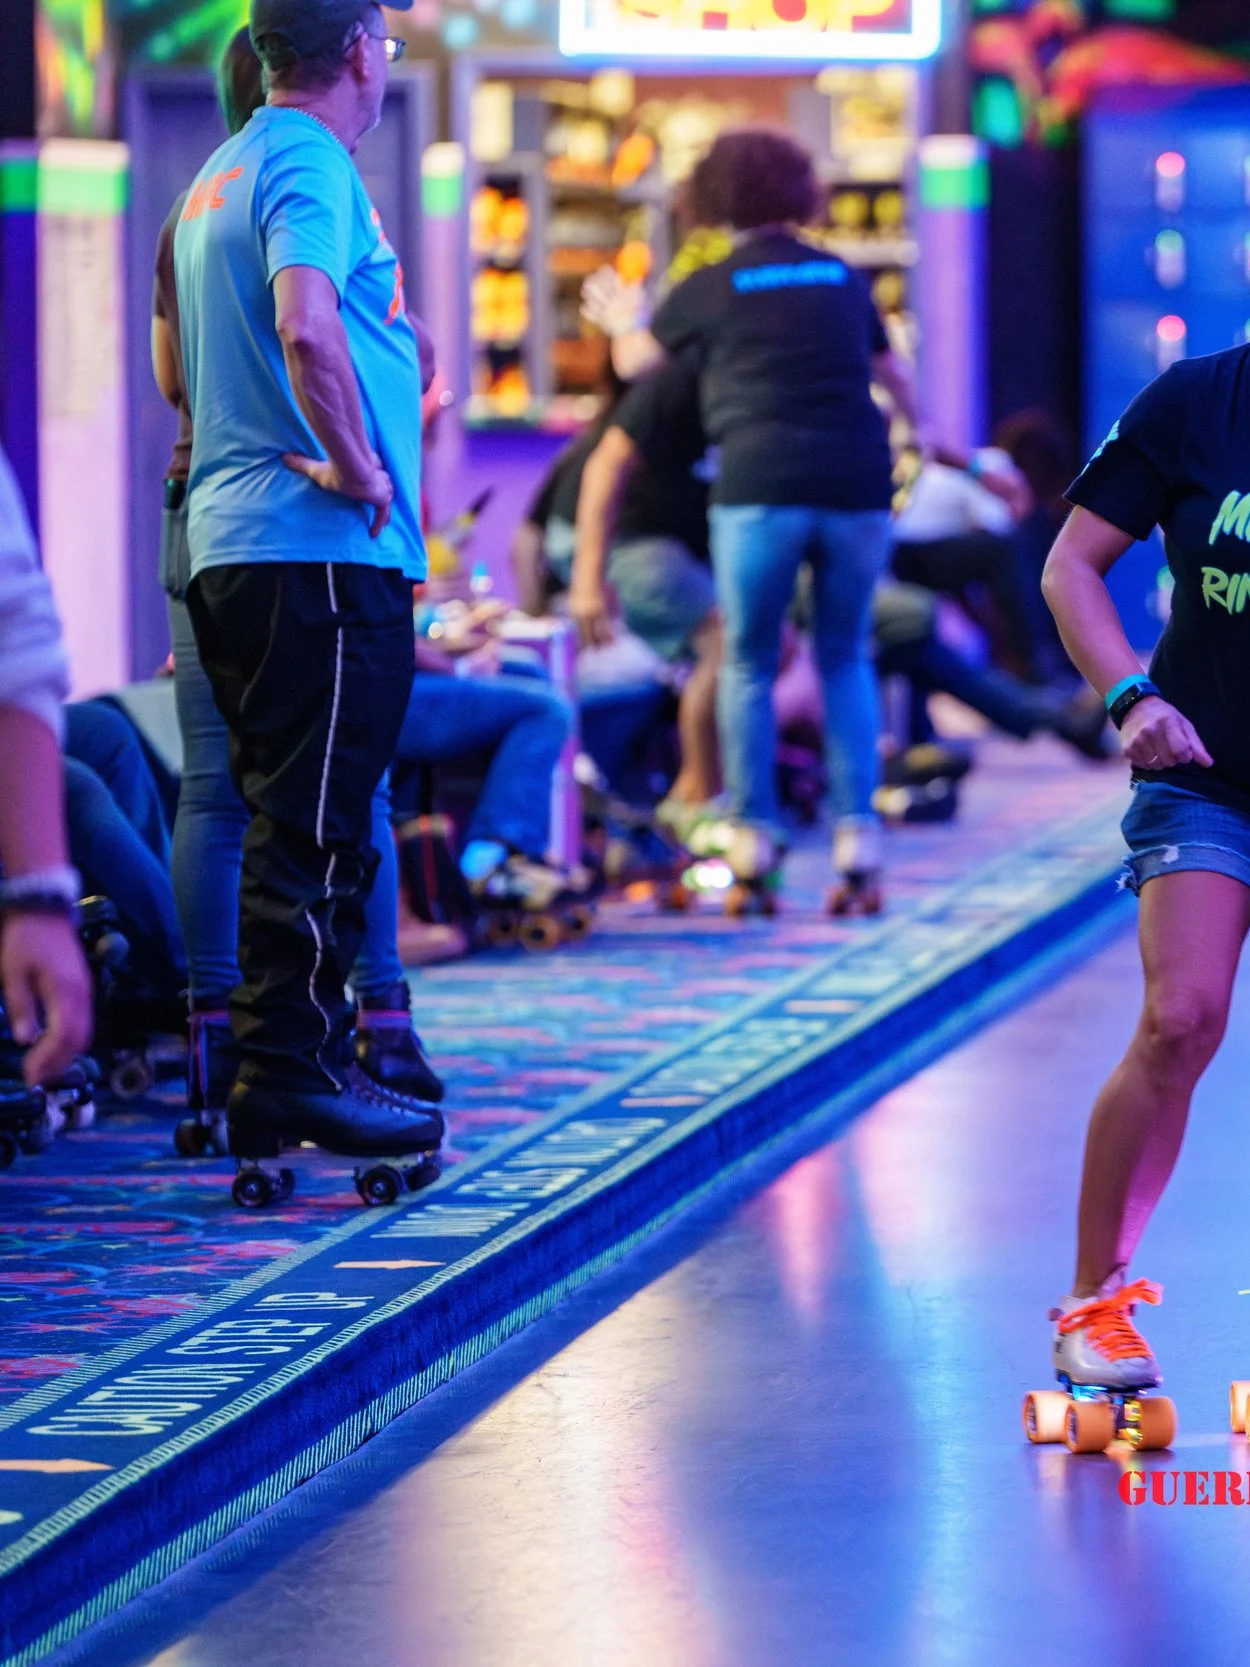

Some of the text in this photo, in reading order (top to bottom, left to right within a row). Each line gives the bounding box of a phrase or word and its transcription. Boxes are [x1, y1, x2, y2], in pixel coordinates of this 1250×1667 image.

[26, 1292, 375, 1436] CAUTION STEP UP
